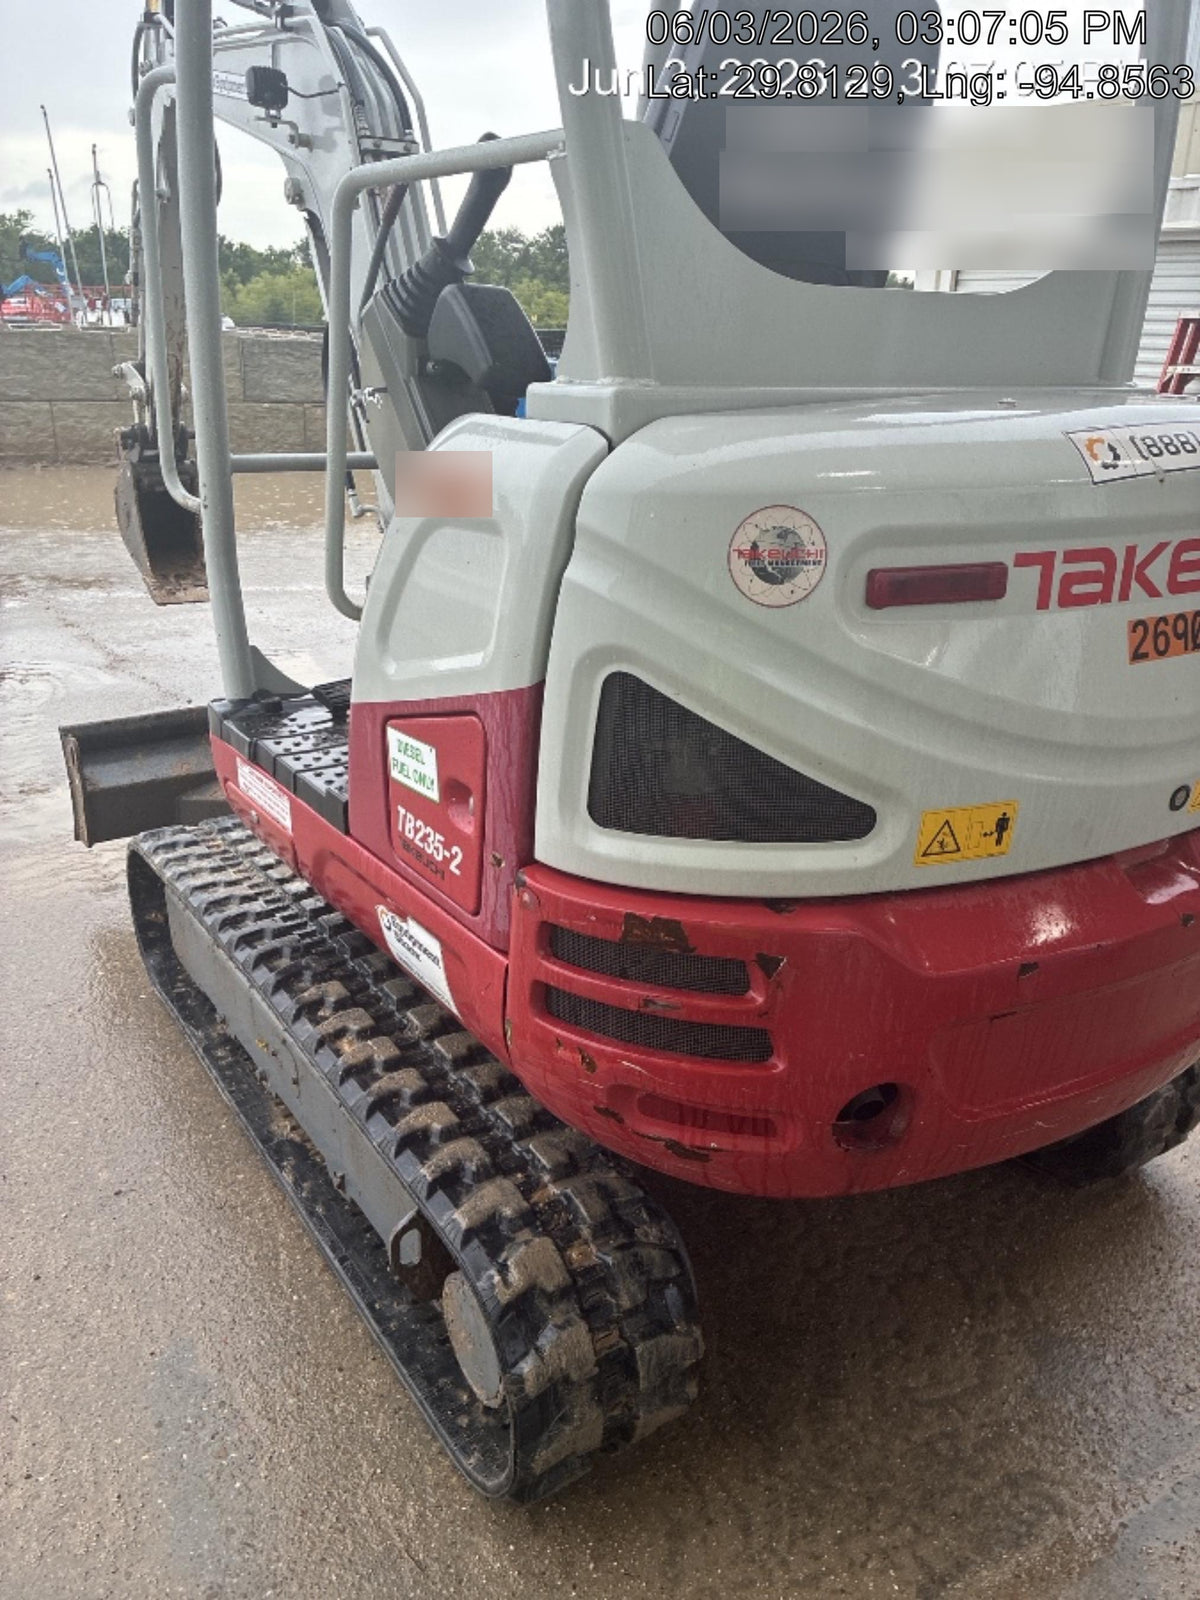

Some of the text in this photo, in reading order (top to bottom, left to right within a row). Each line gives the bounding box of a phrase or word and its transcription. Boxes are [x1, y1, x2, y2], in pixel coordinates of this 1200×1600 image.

[397, 739, 426, 766] DIESEL
[392, 757, 435, 792] FUEL ONLY
[397, 804, 464, 876] TB235-2
